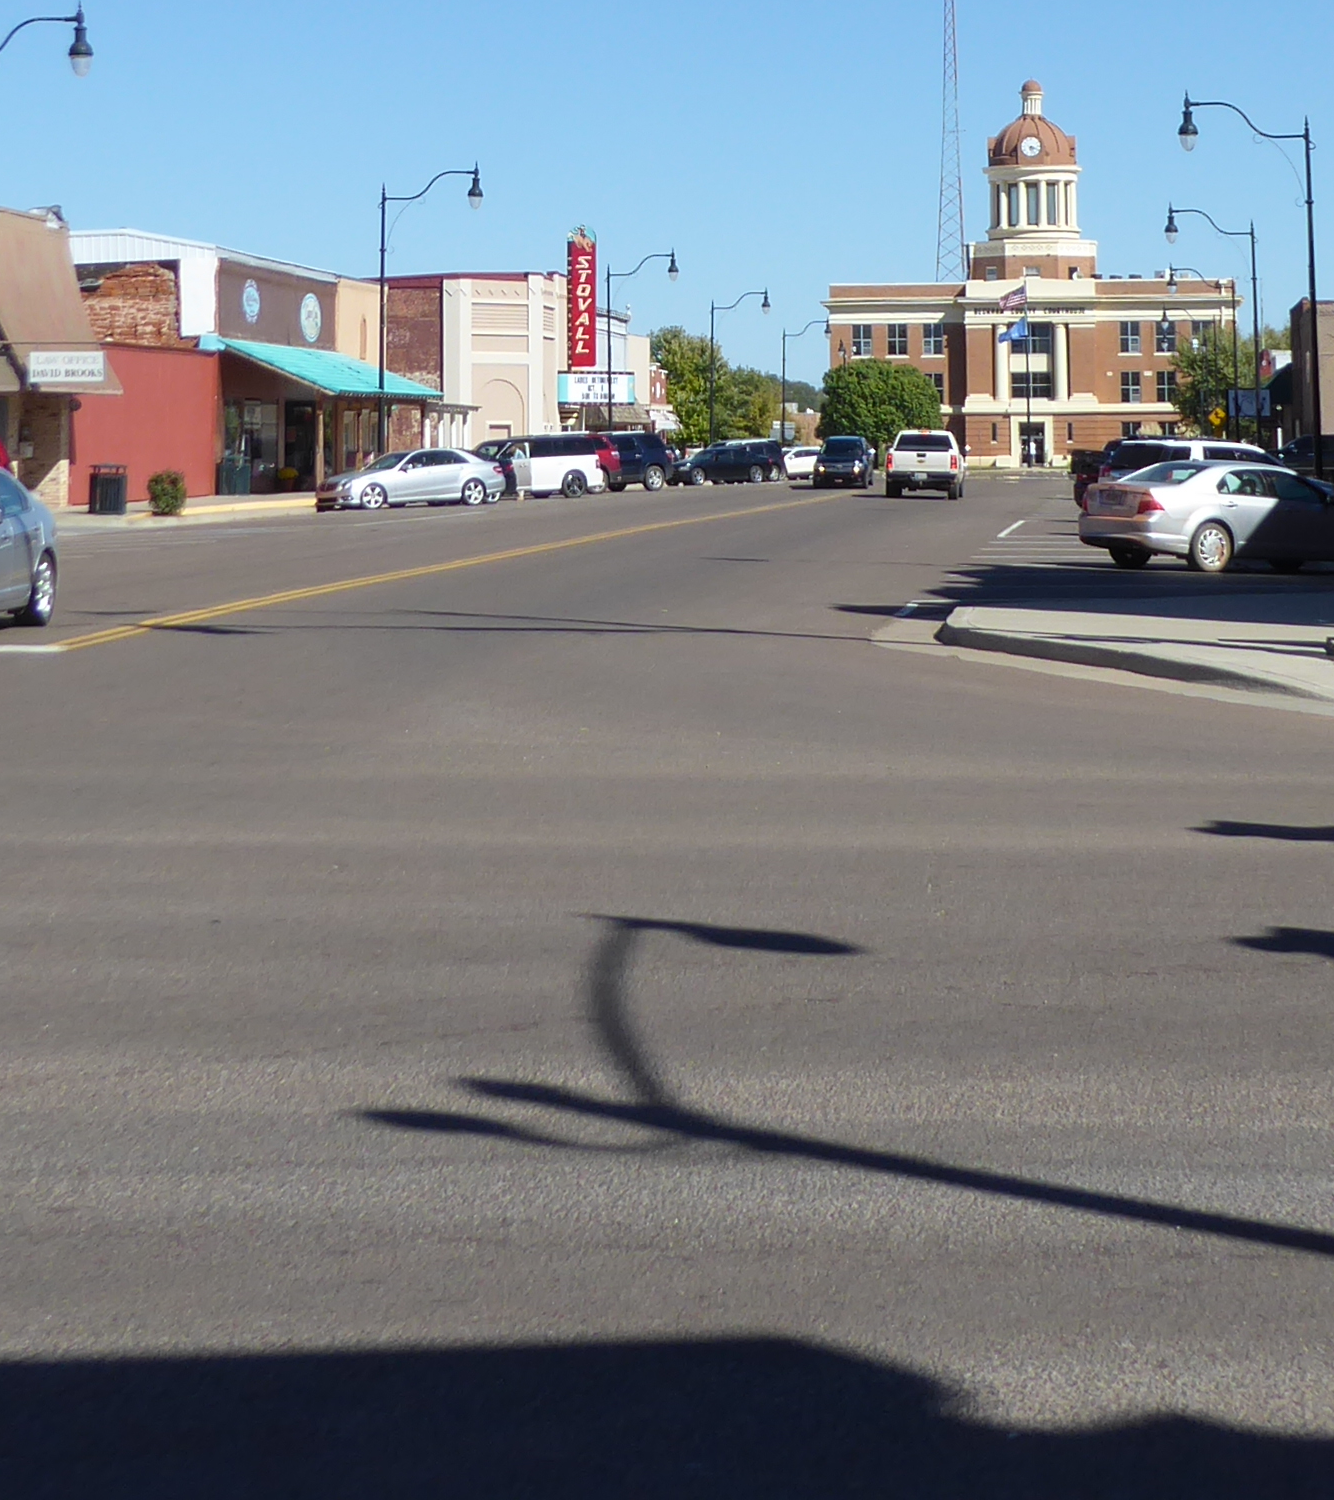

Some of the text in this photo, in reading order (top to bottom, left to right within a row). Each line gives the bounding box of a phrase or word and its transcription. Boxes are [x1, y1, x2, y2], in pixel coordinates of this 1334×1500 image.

[575, 256, 592, 354] STOVALL
[36, 355, 99, 365] LAW OFFICE
[32, 368, 103, 378] DAVID BROOKS
